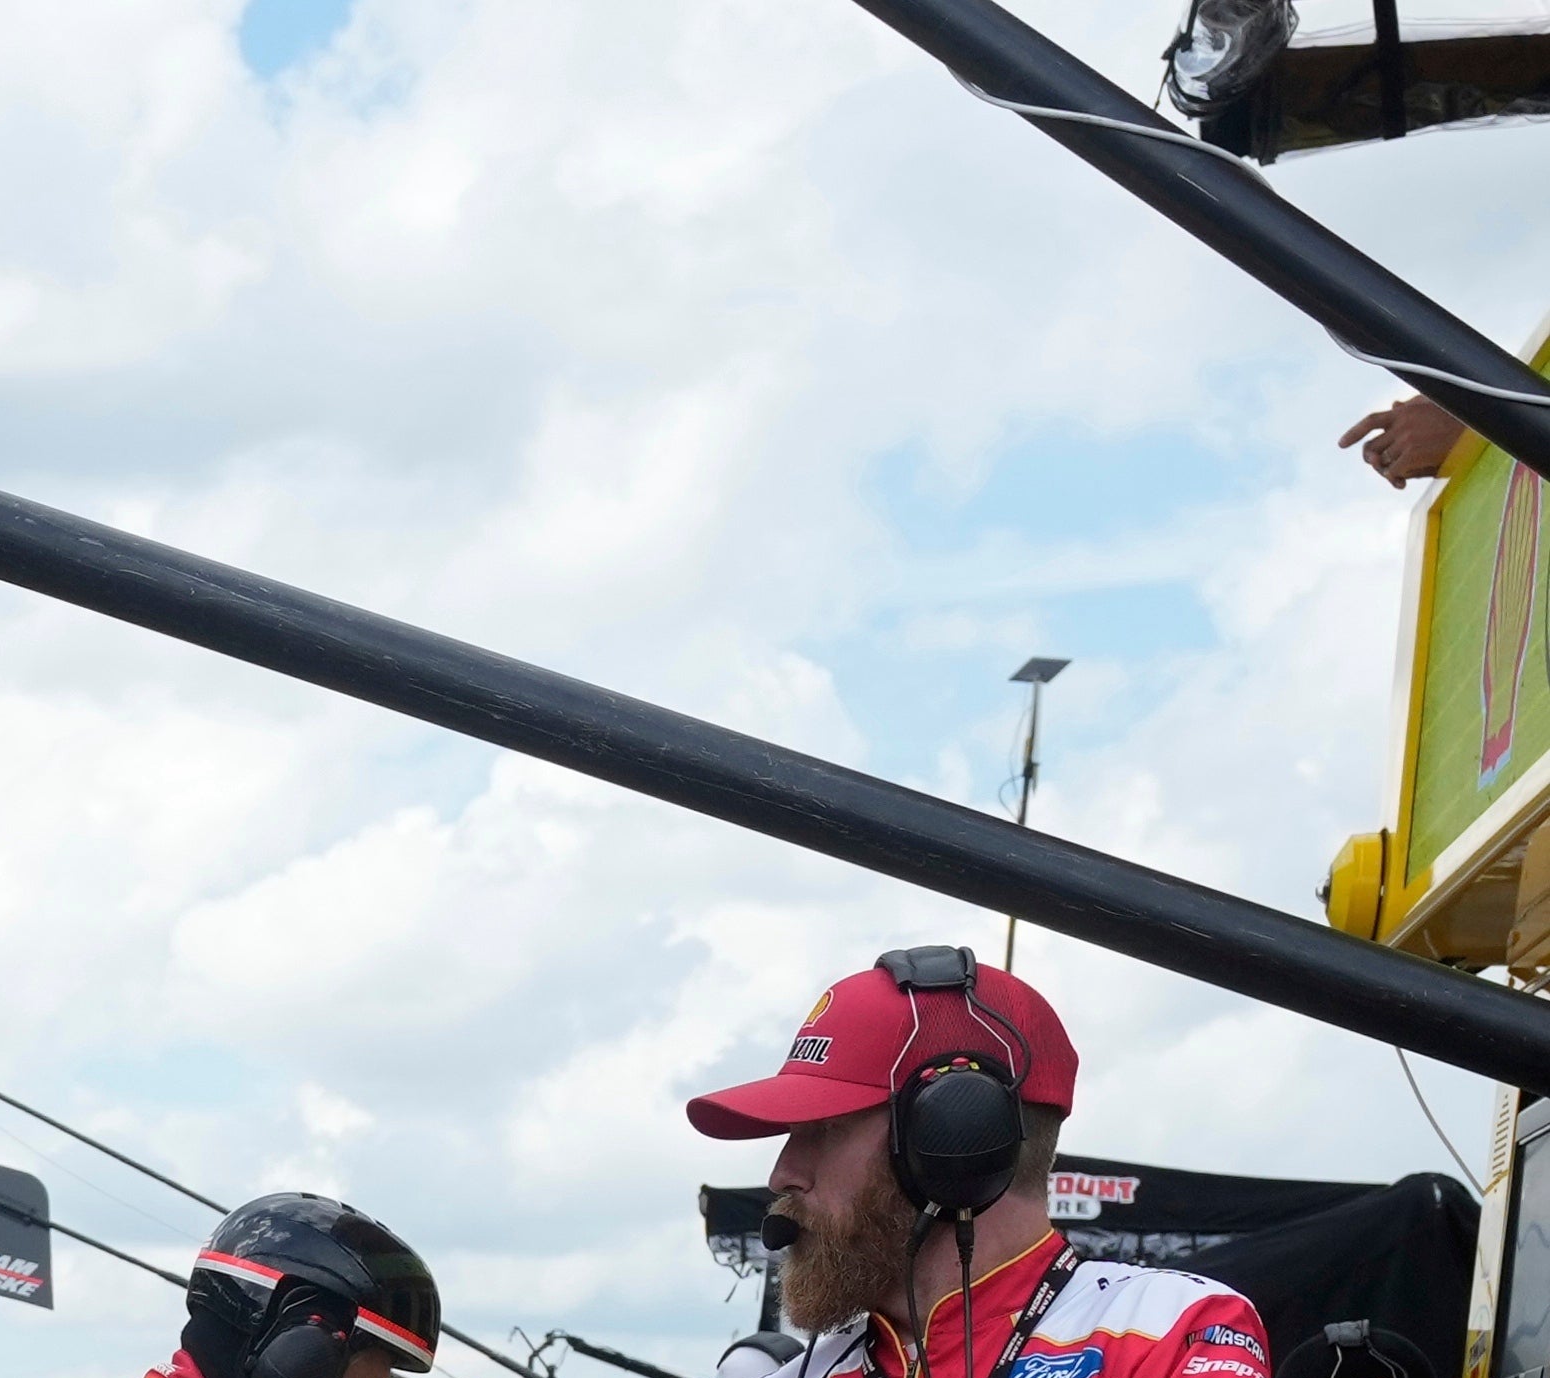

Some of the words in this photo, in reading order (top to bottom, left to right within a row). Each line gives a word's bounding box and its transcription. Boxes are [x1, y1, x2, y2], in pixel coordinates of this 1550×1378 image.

[789, 1037, 833, 1064] NZOIL
[1050, 1172, 1139, 1203] OUNT
[1056, 1201, 1090, 1216] RE
[1025, 1282, 1050, 1320] PENSKE
[1037, 1290, 1056, 1316] TEAM
[1007, 1334, 1025, 1363] TEAM
